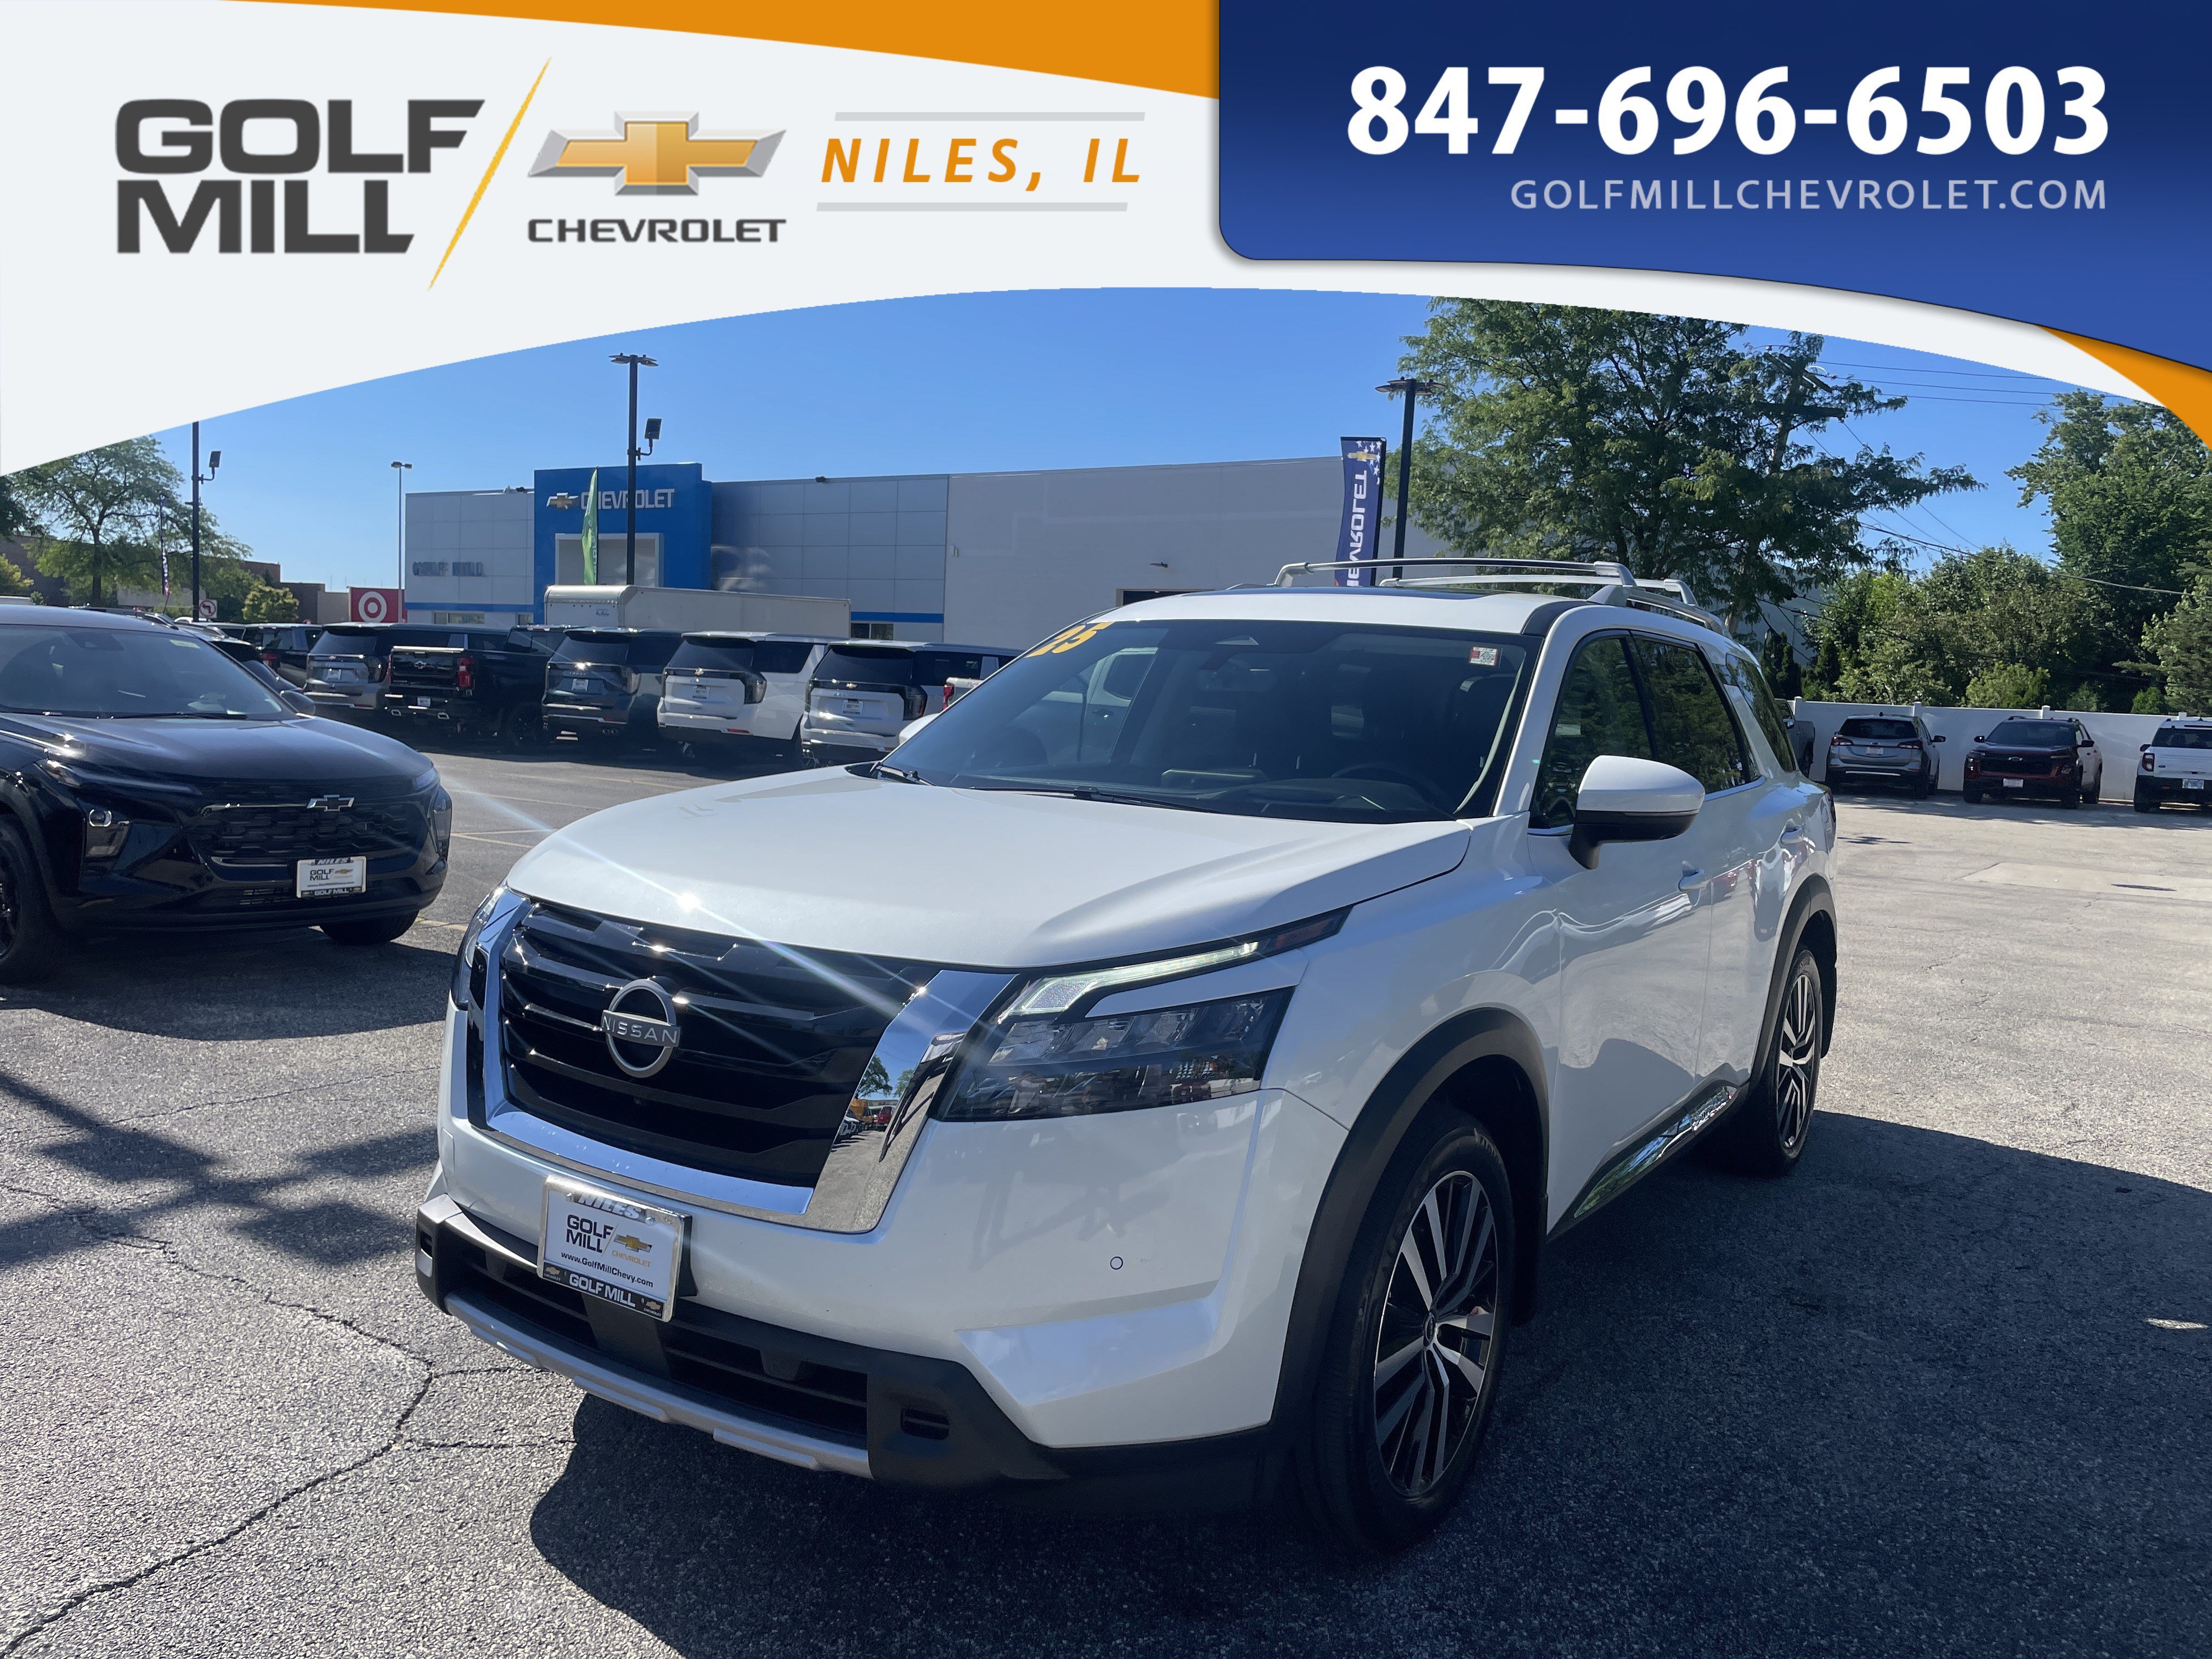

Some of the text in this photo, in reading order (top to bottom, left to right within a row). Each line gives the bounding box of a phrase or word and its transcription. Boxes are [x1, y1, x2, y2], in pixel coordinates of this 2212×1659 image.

[1025, 622, 1115, 658] 25
[602, 1015, 678, 1043] NISSAN
[578, 1194, 641, 1219] NILES
[567, 1214, 614, 1239] GOLF
[566, 1228, 603, 1253] MILL
[561, 1252, 653, 1288] www.GolfMillChevy.com
[612, 1250, 651, 1268] CHEVROLET
[569, 1273, 635, 1307] GOLF MILL
